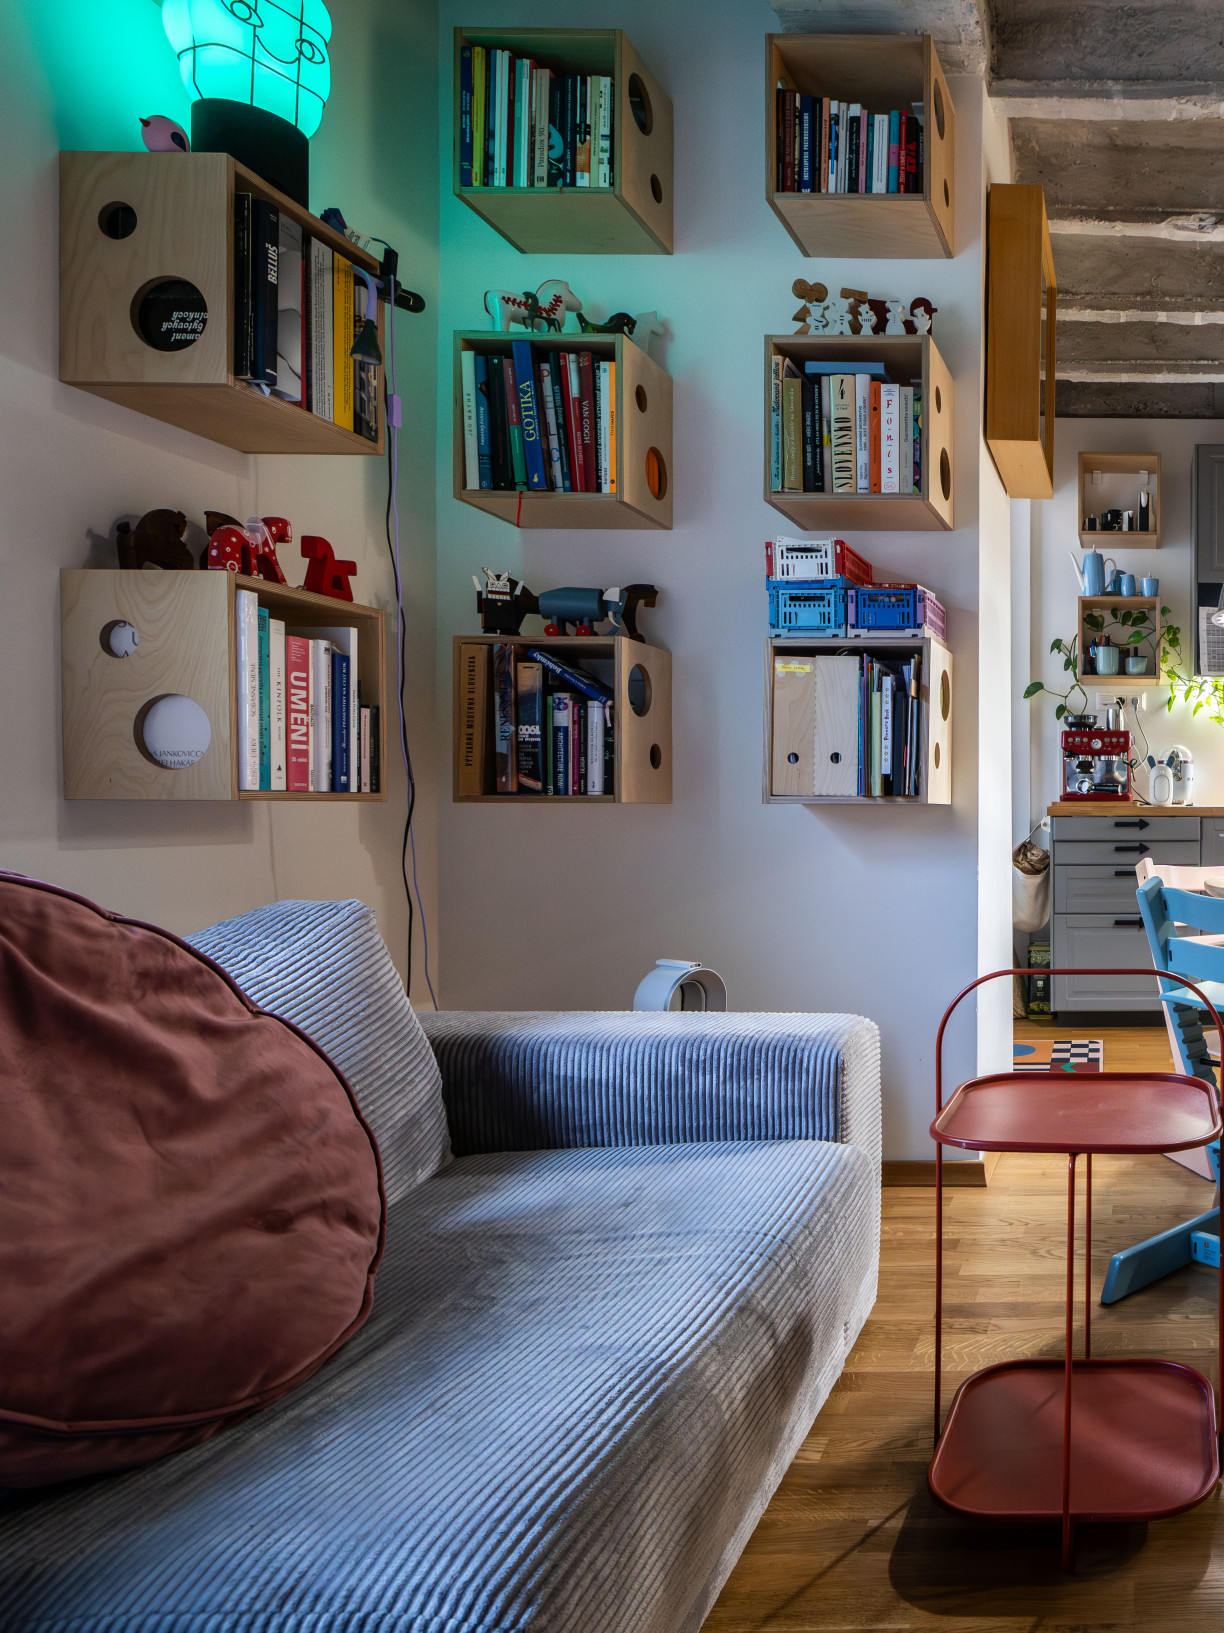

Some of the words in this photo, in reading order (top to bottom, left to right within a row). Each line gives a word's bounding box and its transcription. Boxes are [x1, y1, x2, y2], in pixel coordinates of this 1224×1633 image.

[267, 242, 278, 285] BELLUŠ
[519, 380, 536, 441] GOTIKA
[833, 416, 853, 489] SLOVENSKO
[467, 655, 476, 694] SLOVENSKA
[290, 671, 310, 750] UMĚNÍ
[466, 697, 475, 729] MODERNA
[464, 732, 474, 767] VÝTVARNÁ
[556, 731, 564, 772] ARCHITECTURE
